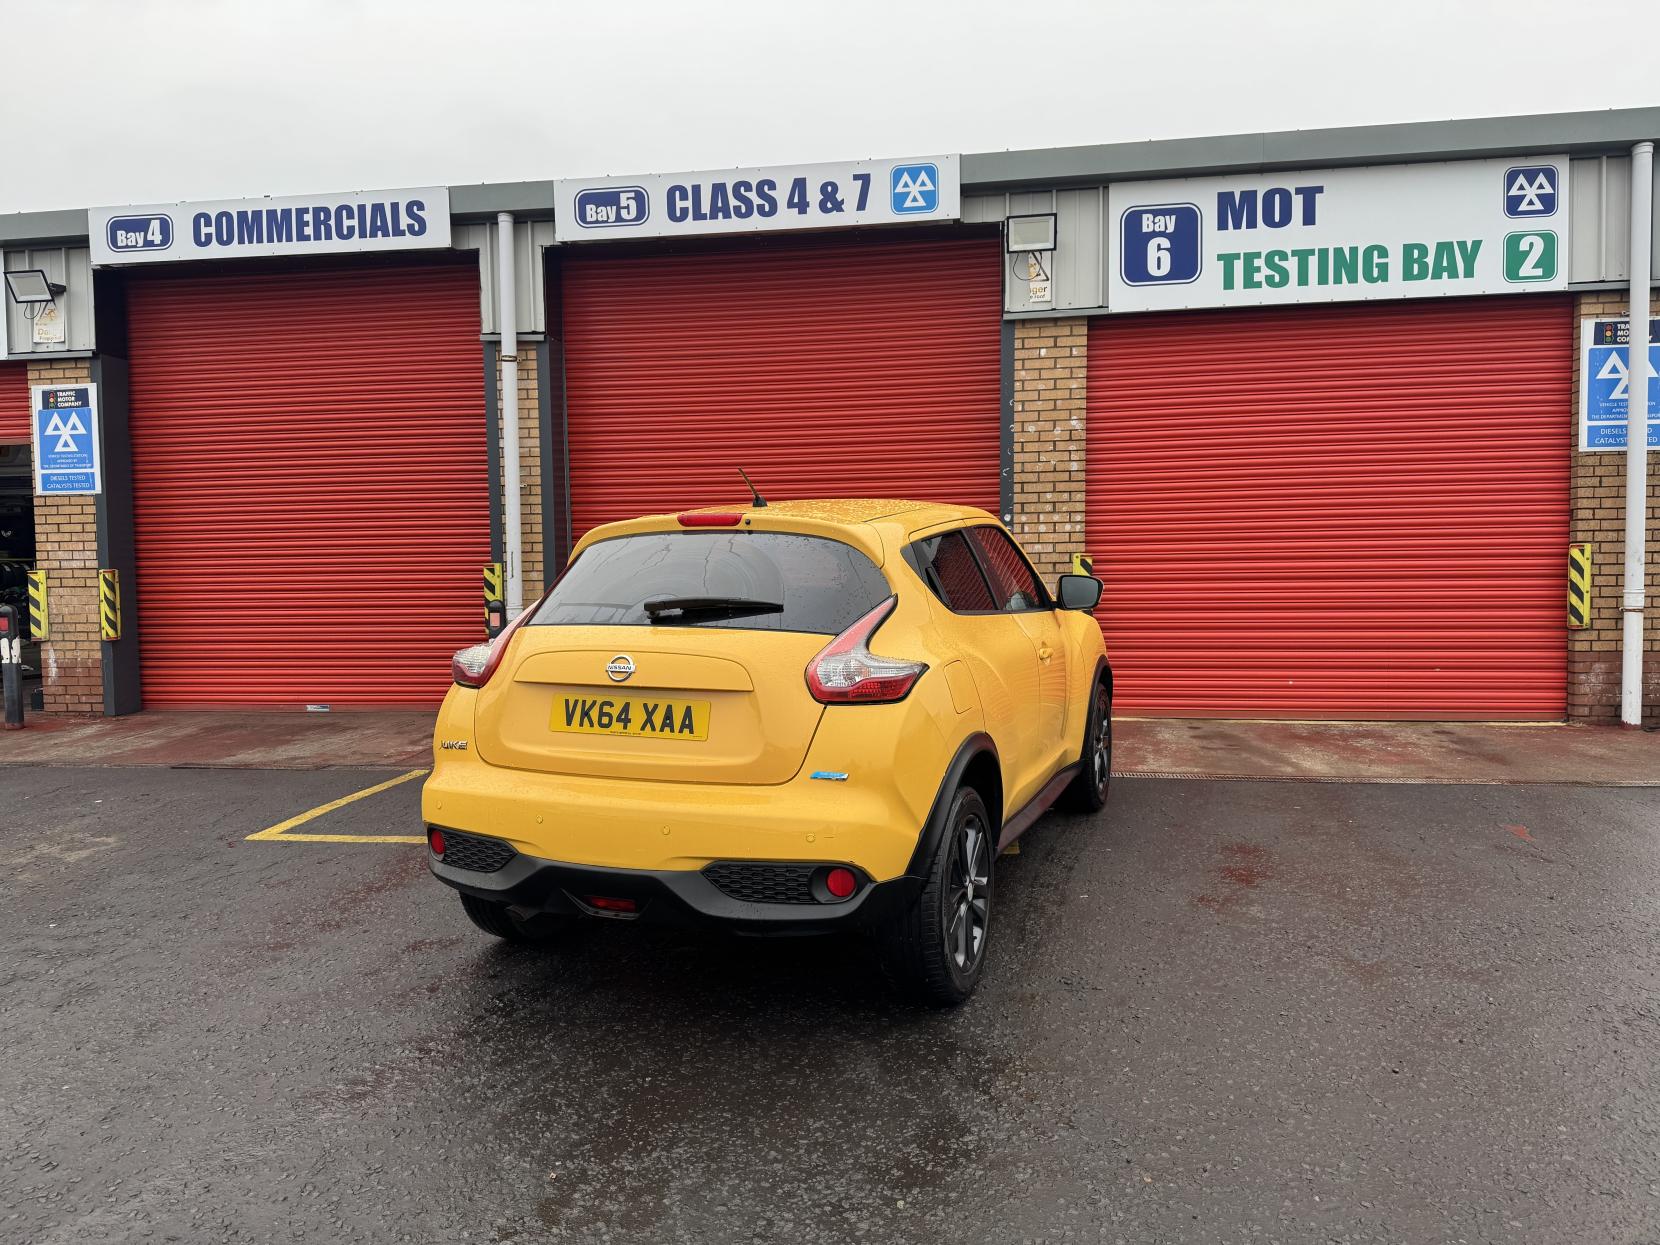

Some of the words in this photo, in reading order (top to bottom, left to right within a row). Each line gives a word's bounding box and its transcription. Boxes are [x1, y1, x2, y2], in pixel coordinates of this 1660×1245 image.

[585, 204, 617, 222] Bay
[619, 192, 637, 220] 5
[666, 179, 778, 223] CLASS
[787, 177, 810, 215] 4
[818, 181, 845, 213] &
[852, 173, 872, 211] 7
[1216, 185, 1325, 231] MOT
[116, 230, 145, 248] Bay
[146, 219, 162, 244] 4
[192, 200, 428, 247] COMMERCIALS
[1141, 213, 1176, 233] Bay
[1146, 236, 1171, 277] 6
[1216, 244, 1389, 291] TESTING
[1402, 239, 1483, 281] BAY
[1518, 235, 1545, 277] 2
[1600, 427, 1627, 435] DIESELS
[564, 698, 632, 730] VK64
[640, 702, 695, 735] XAA
[439, 740, 468, 750] JUKE
